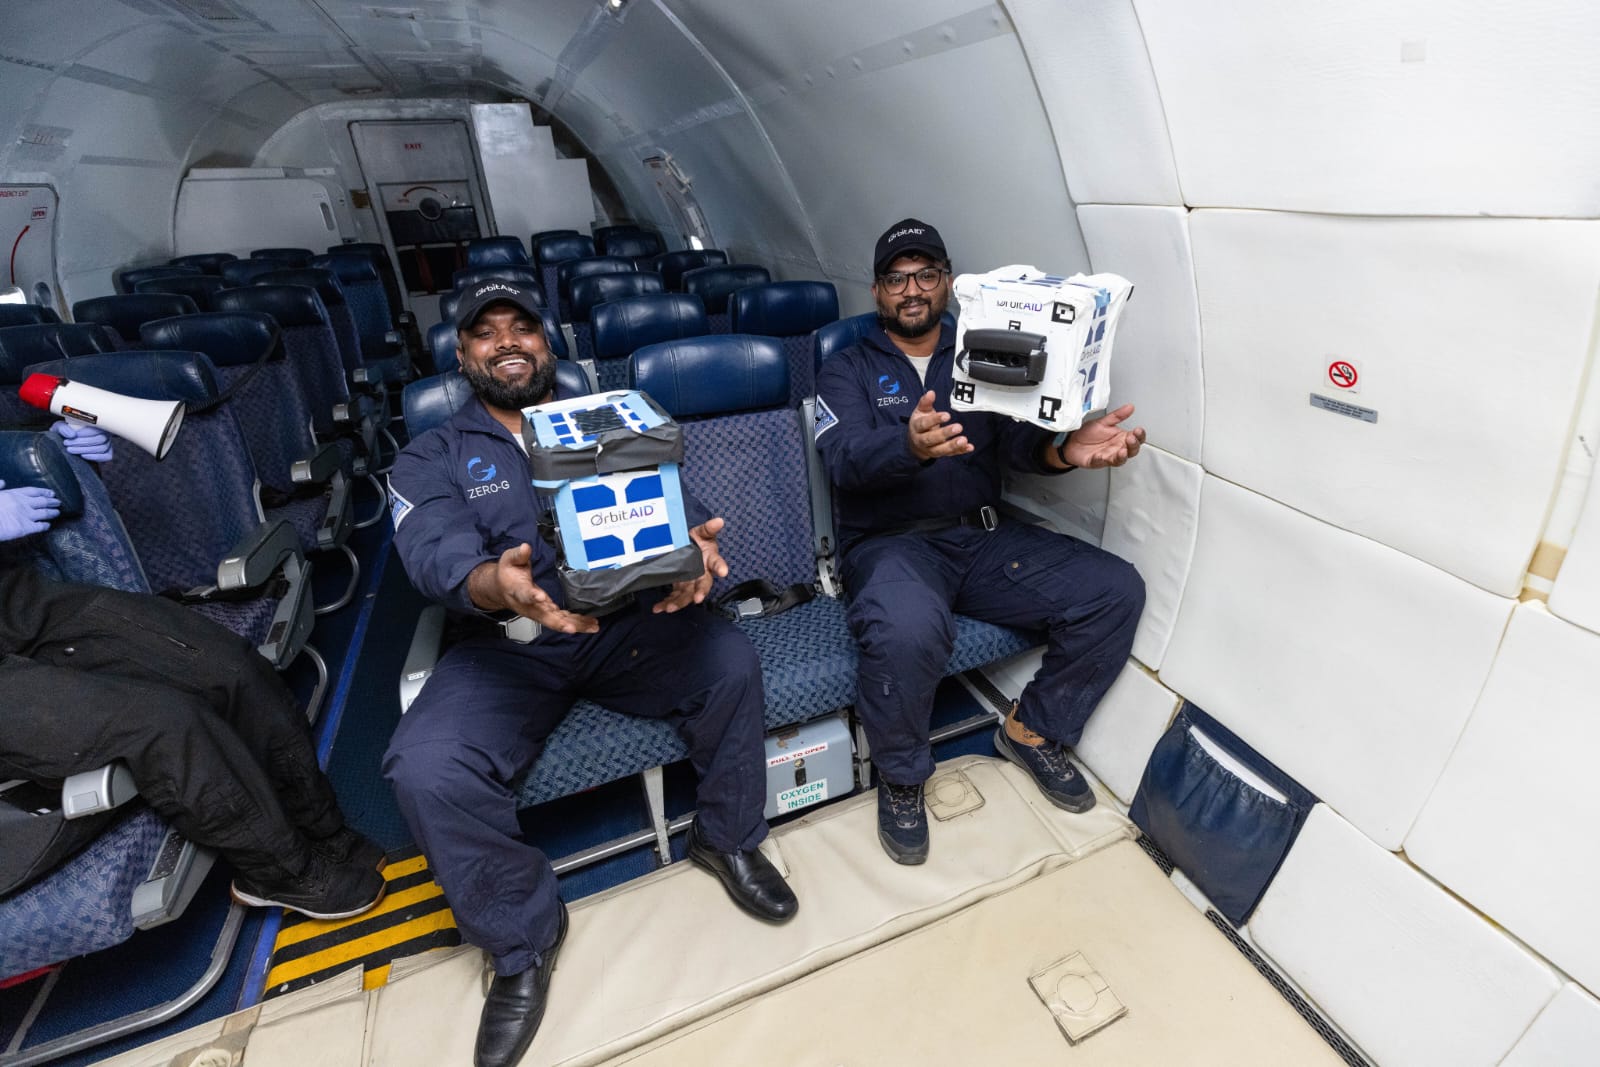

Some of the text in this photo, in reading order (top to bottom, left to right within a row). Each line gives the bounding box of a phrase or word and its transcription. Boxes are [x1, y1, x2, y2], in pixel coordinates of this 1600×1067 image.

[877, 396, 909, 407] ZERO-G
[467, 480, 510, 499] ZERO-G
[770, 756, 790, 765] PULL
[805, 745, 826, 755] OPEN
[780, 782, 824, 801] OXYGEN
[787, 793, 822, 809] INSIDE
